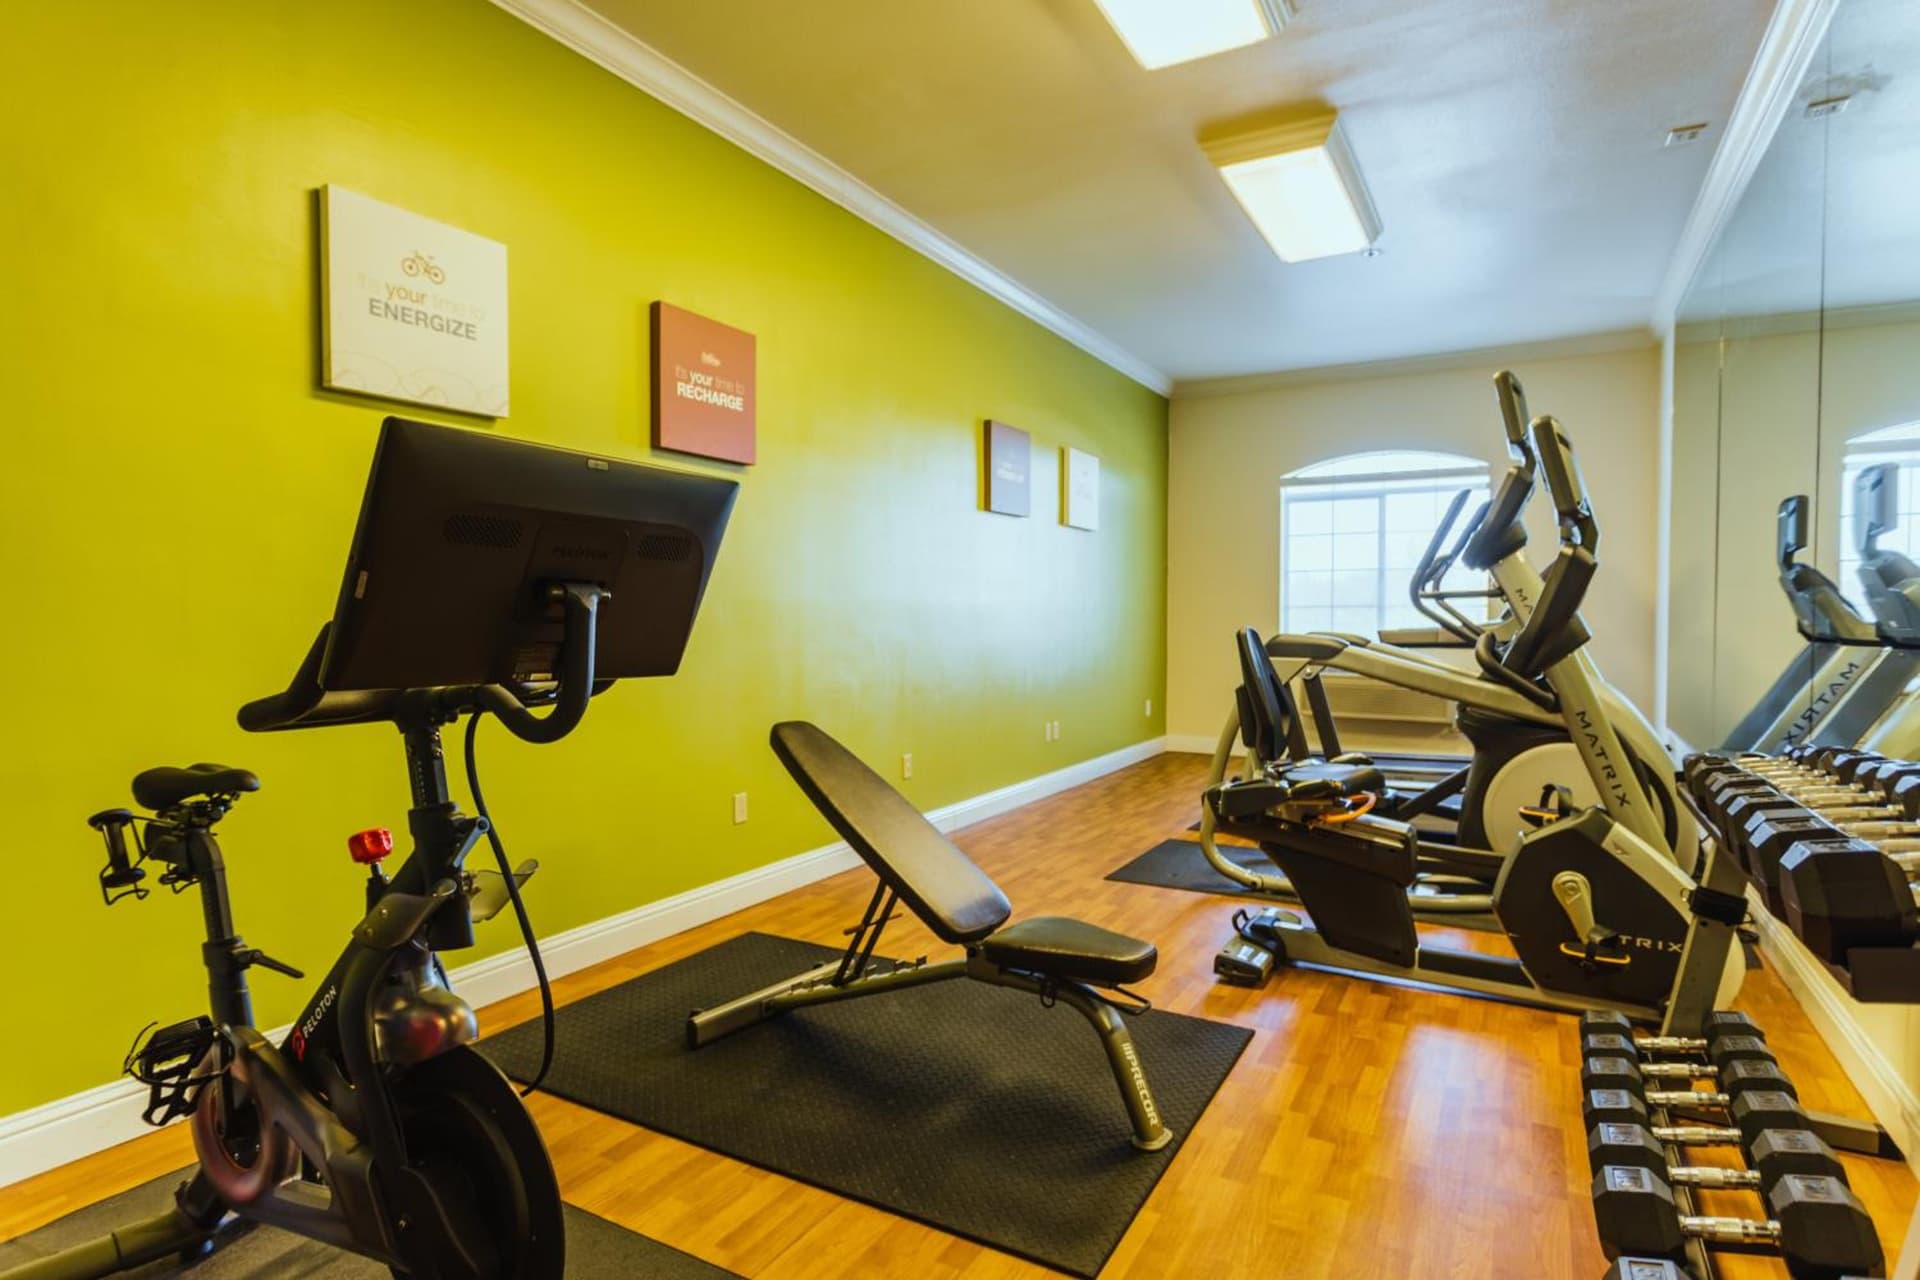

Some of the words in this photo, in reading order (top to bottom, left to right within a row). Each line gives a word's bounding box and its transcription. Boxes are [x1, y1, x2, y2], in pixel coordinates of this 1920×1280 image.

[385, 280, 427, 305] your
[368, 297, 478, 341] ENERGIZE
[676, 380, 745, 412] RECHARGE
[690, 370, 713, 387] your
[1575, 710, 1632, 808] MATRIX
[1618, 934, 1683, 953] TRIX
[302, 985, 337, 1039] PELOTON
[1125, 1053, 1160, 1127] PRECOR
